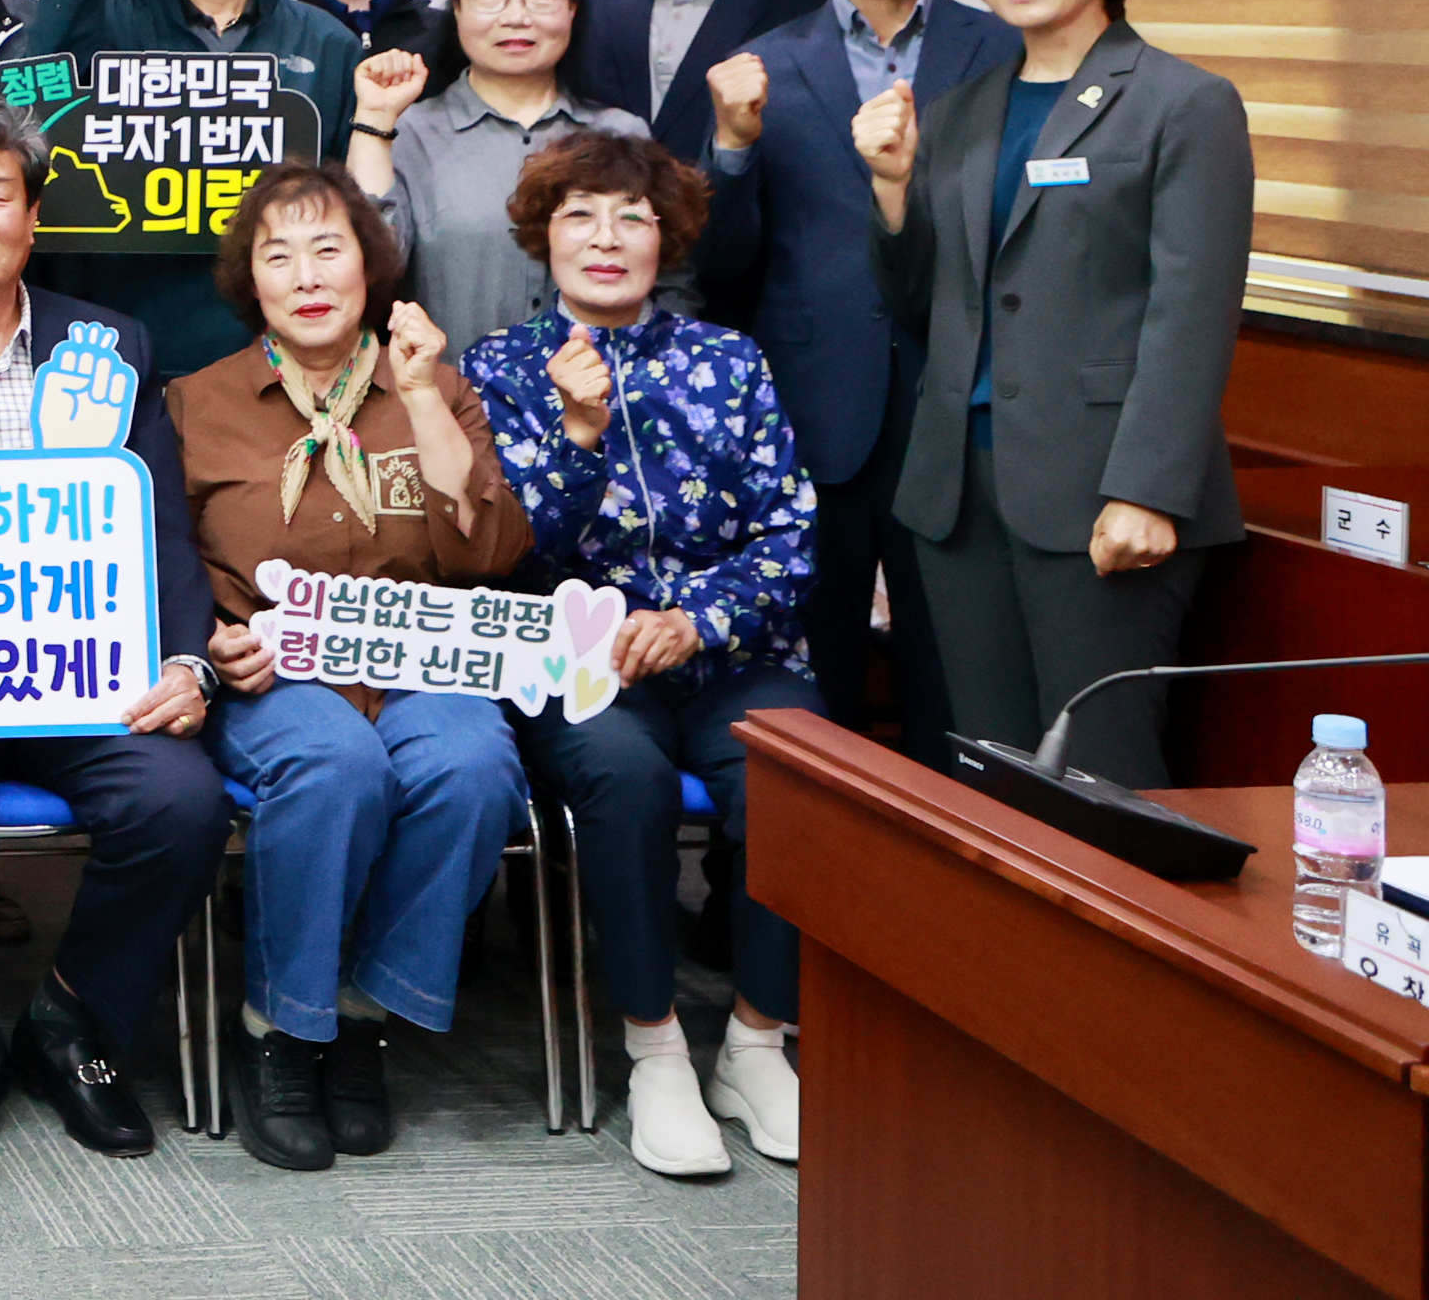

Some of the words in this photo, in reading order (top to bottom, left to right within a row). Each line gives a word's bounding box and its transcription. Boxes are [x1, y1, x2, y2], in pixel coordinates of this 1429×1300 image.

[0, 59, 74, 107] 청렴
[97, 58, 273, 109] 대한민국
[81, 114, 285, 165] 부자1번지
[283, 576, 455, 633] 의심없는
[471, 594, 555, 643] 행정
[279, 630, 407, 680] 령원한
[419, 646, 504, 692] 신뢰
